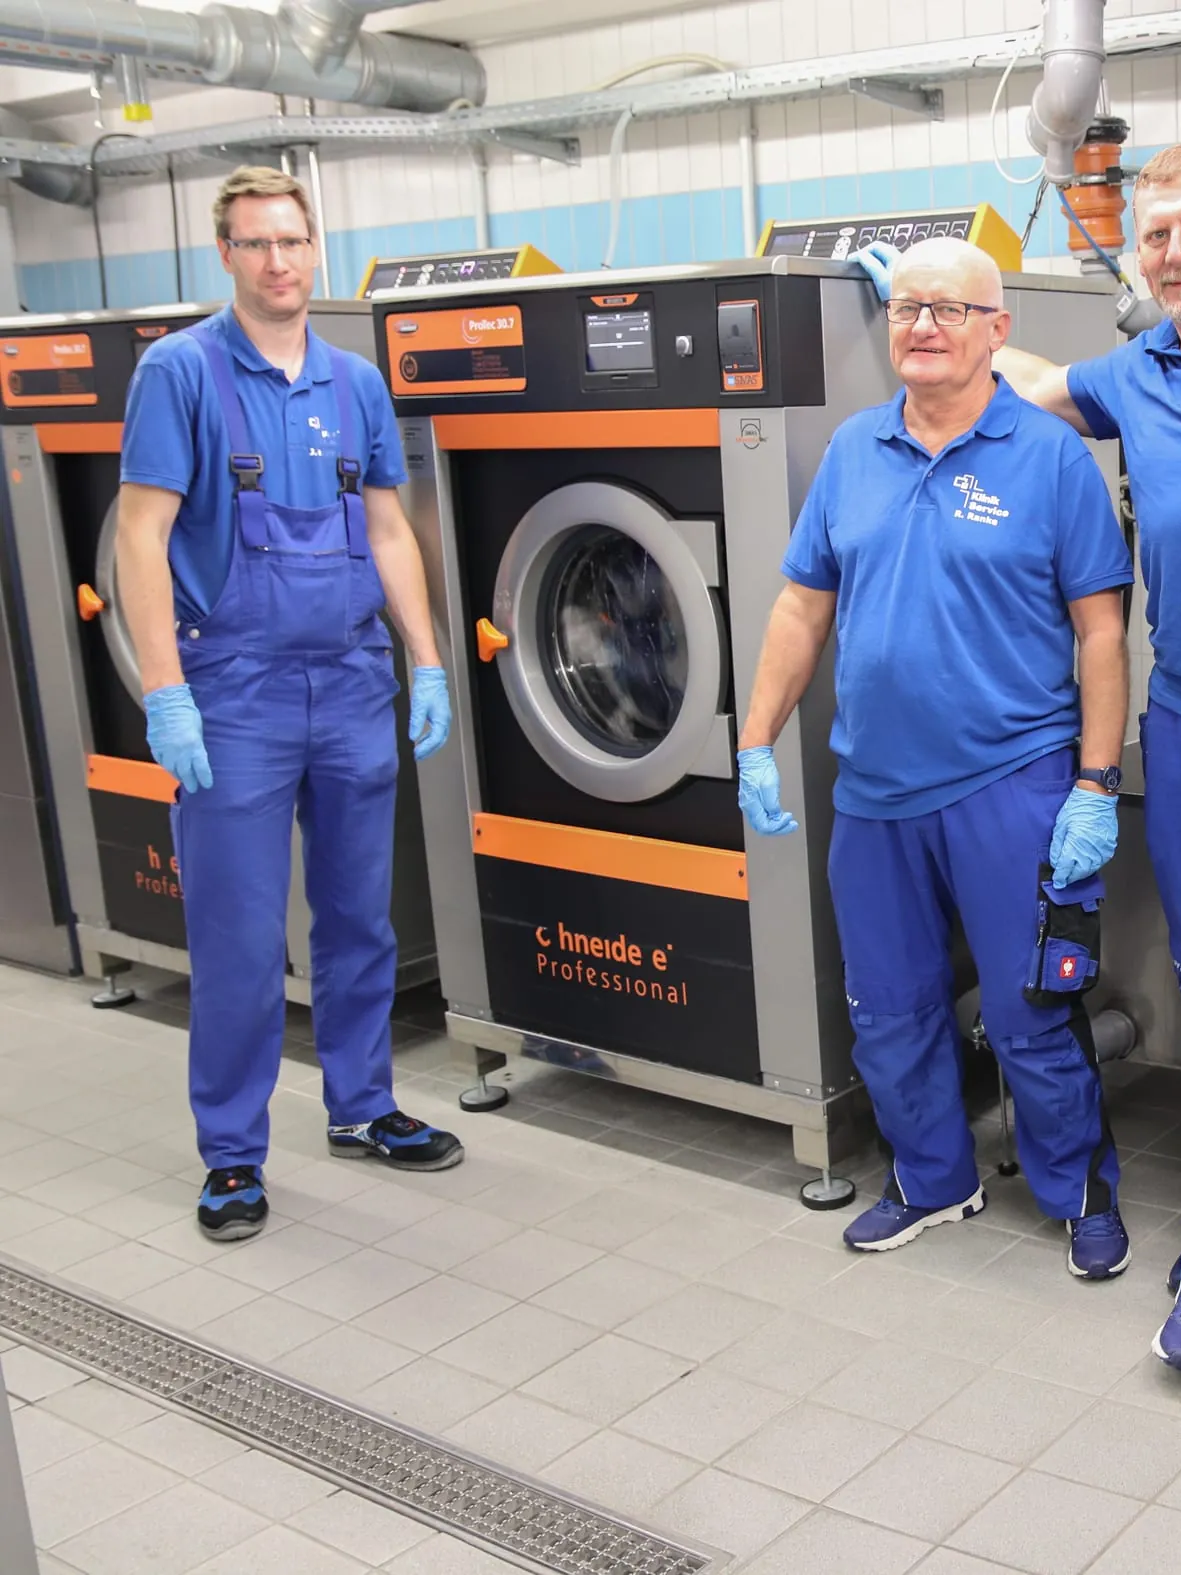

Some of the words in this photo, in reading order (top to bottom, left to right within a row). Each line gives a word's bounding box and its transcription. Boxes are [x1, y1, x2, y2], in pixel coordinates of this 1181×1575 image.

[971, 492, 1000, 505] Klinik
[969, 502, 1009, 517] Service
[536, 952, 688, 1006] Professional
